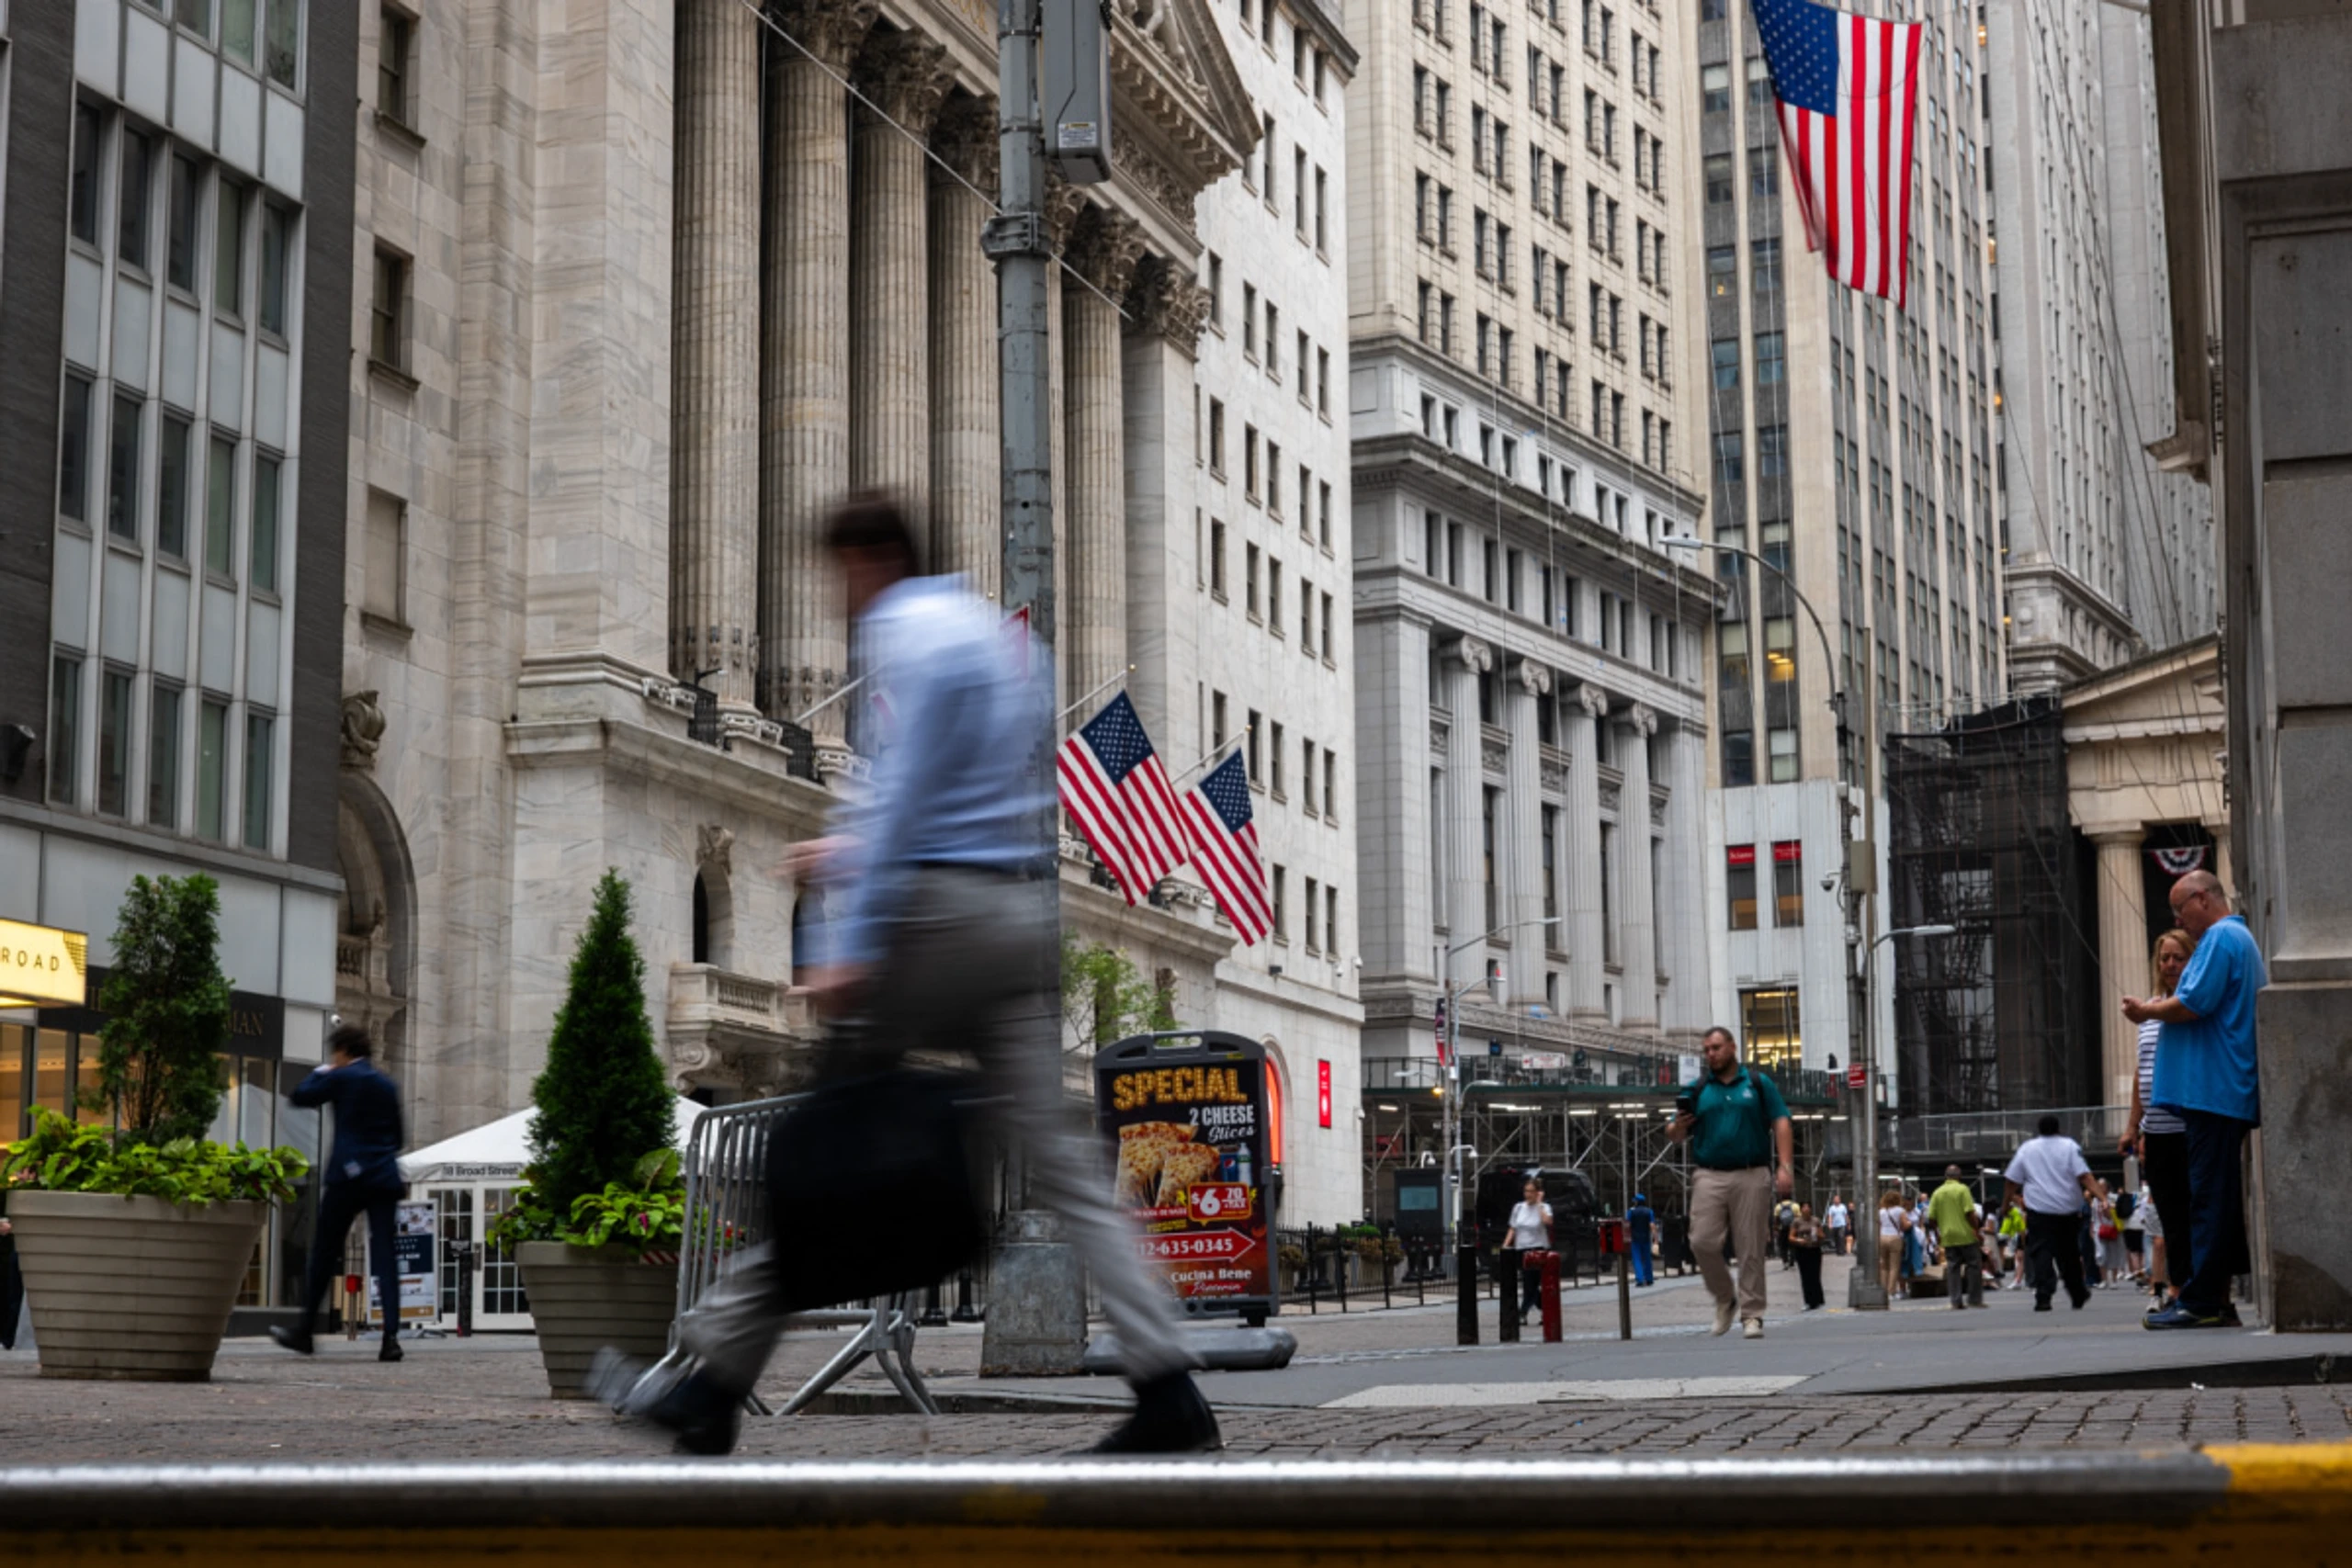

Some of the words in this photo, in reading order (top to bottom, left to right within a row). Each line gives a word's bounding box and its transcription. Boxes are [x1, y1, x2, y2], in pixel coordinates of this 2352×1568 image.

[1113, 1066, 1248, 1111] SPECIAL
[1189, 1107, 1199, 1126] 2
[1202, 1104, 1255, 1126] CHEESE
[457, 1166, 486, 1176] Broad
[488, 1165, 518, 1176] Street
[1136, 1238, 1233, 1258] 12-635-0345
